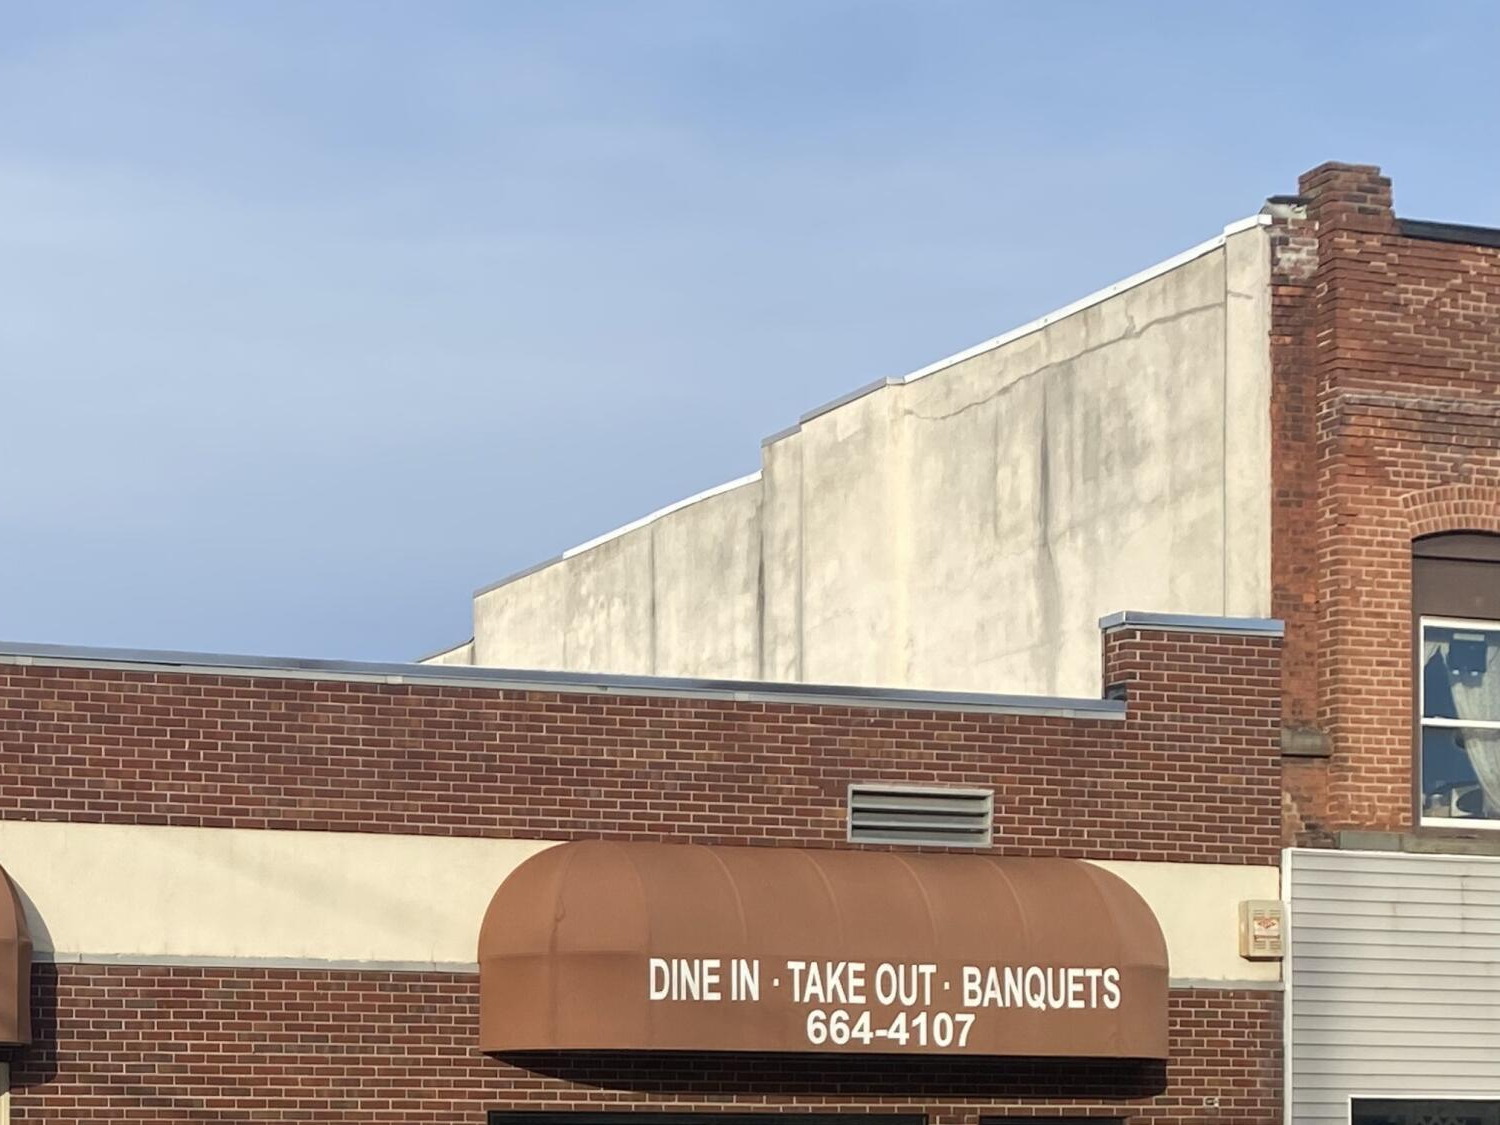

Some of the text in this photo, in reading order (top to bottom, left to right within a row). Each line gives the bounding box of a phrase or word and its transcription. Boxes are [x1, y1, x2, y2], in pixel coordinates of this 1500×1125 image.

[649, 957, 1121, 1011] DINE IN TAKE OUT BANQUETS
[806, 1009, 976, 1048] 664-4107
